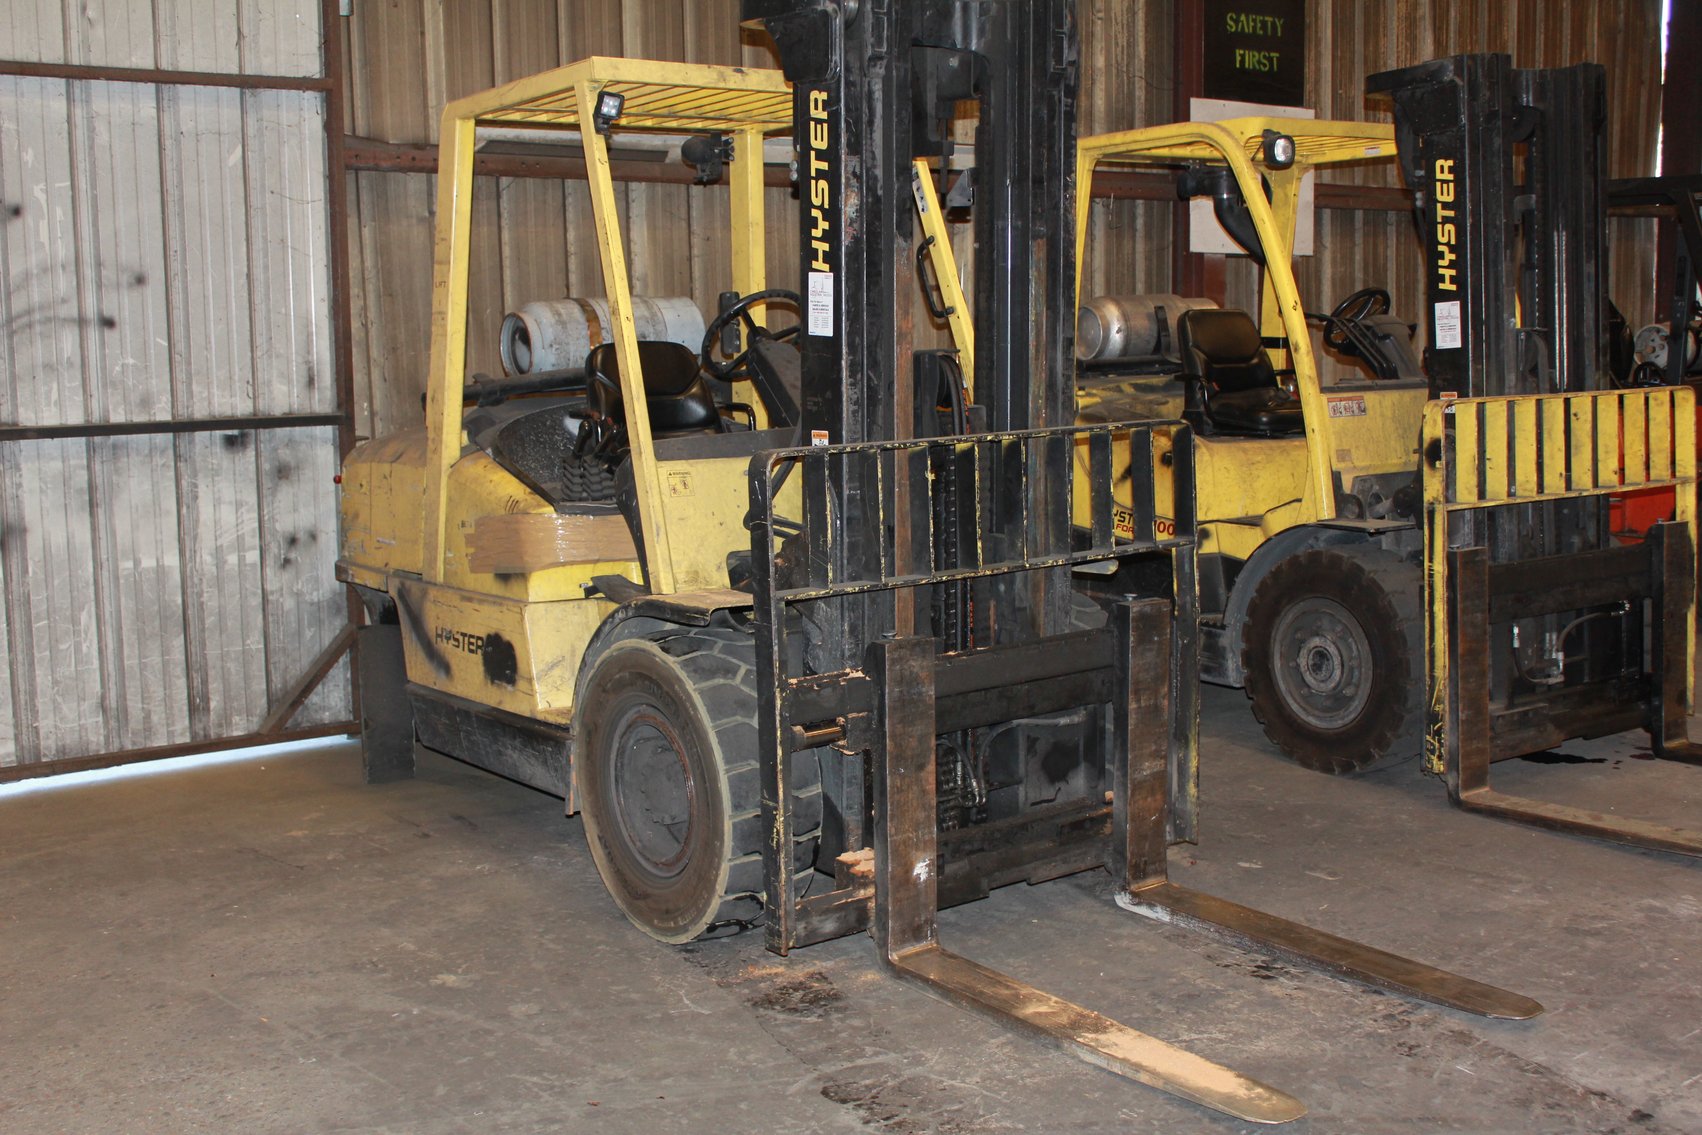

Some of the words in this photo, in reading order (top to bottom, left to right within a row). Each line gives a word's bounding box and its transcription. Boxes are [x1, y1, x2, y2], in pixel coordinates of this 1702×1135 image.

[1226, 12, 1284, 37] SAFETY
[1235, 48, 1280, 72] FIRST
[809, 89, 830, 273] HYSTER
[1435, 158, 1457, 291] HYSTER
[434, 625, 485, 656] HYSTER
